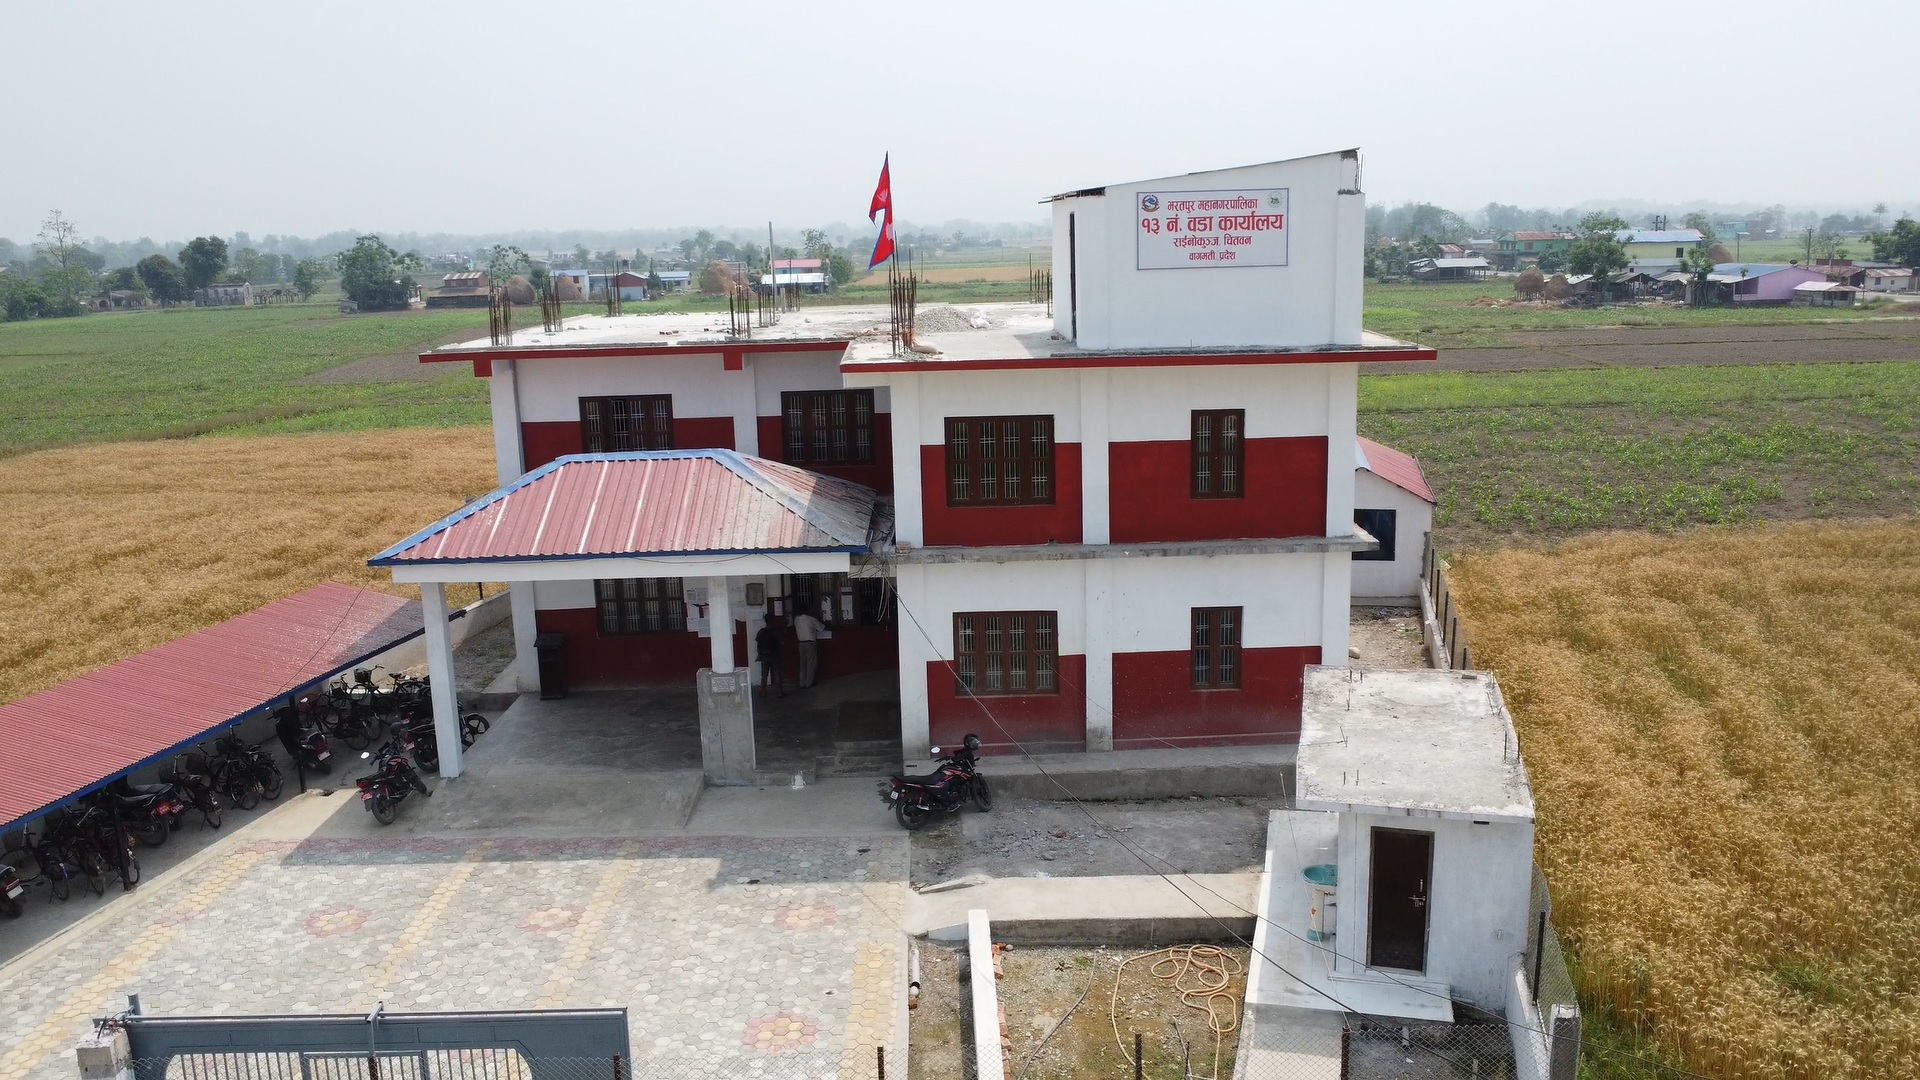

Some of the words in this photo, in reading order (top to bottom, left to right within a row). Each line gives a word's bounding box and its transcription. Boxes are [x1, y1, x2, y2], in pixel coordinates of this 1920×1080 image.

[1167, 200, 1196, 213] भरतपुर
[1198, 195, 1258, 211] महानगरपालिका
[1141, 218, 1160, 235] १३
[1166, 214, 1182, 233] नं.
[1187, 216, 1214, 232] वडा
[1218, 211, 1284, 231] कार्यालय
[1224, 233, 1252, 246] चितवन
[1219, 249, 1236, 261] प्रदेश
